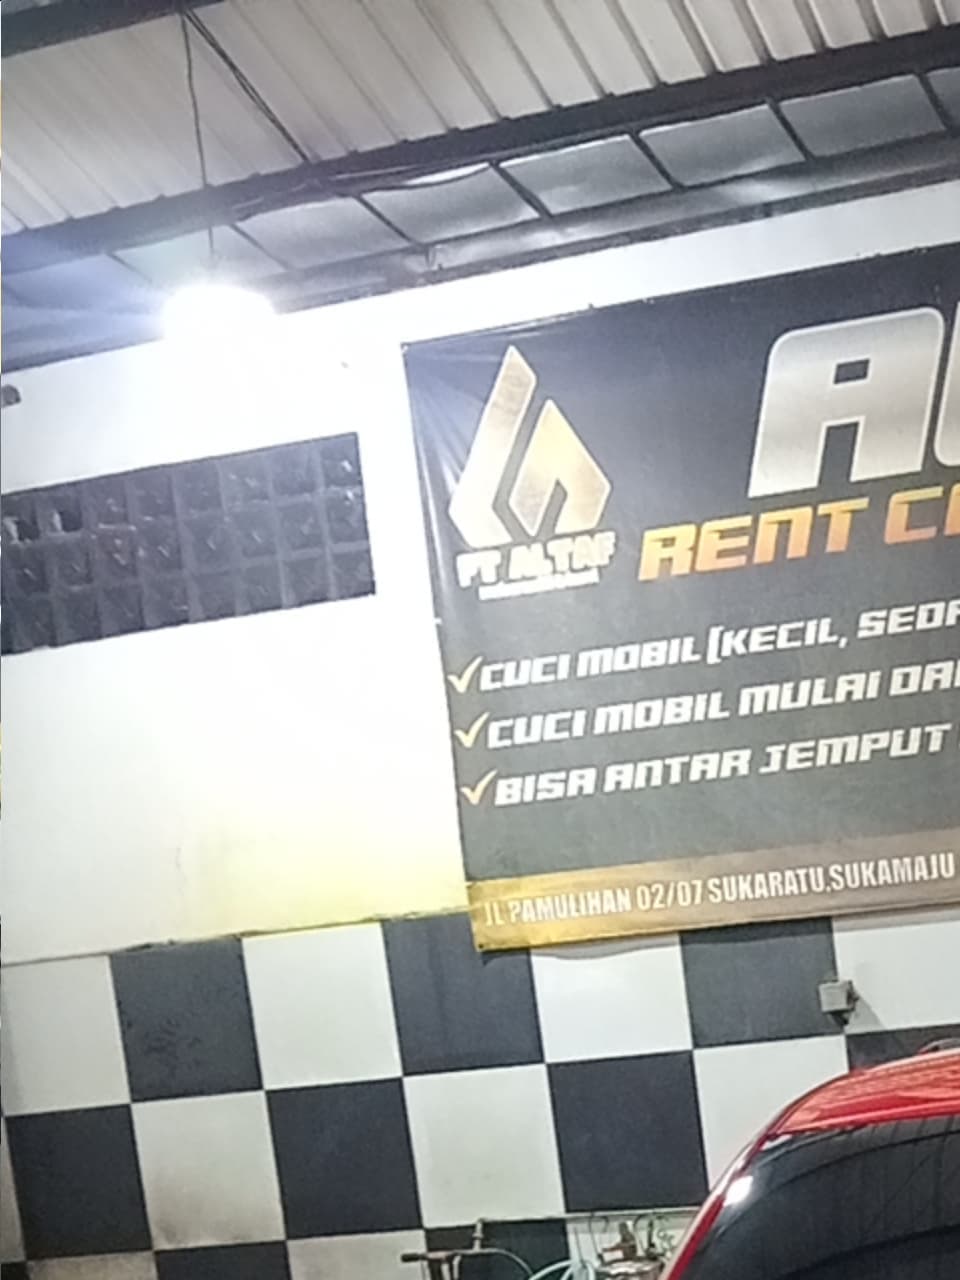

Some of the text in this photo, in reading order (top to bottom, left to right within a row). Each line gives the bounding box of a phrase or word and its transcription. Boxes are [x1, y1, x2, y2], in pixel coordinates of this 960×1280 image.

[638, 497, 869, 581] RENT
[480, 658, 570, 692] CUCI
[576, 636, 700, 679] MOBIL
[487, 713, 587, 749] CUCI
[593, 690, 730, 735] MOBIL
[739, 669, 879, 714] MULAI
[495, 767, 597, 807] BISA
[604, 746, 751, 793] ANTAR
[759, 723, 952, 775] JEMPUT
[509, 888, 632, 924] PAMULIHAN
[636, 879, 703, 911] 02/07
